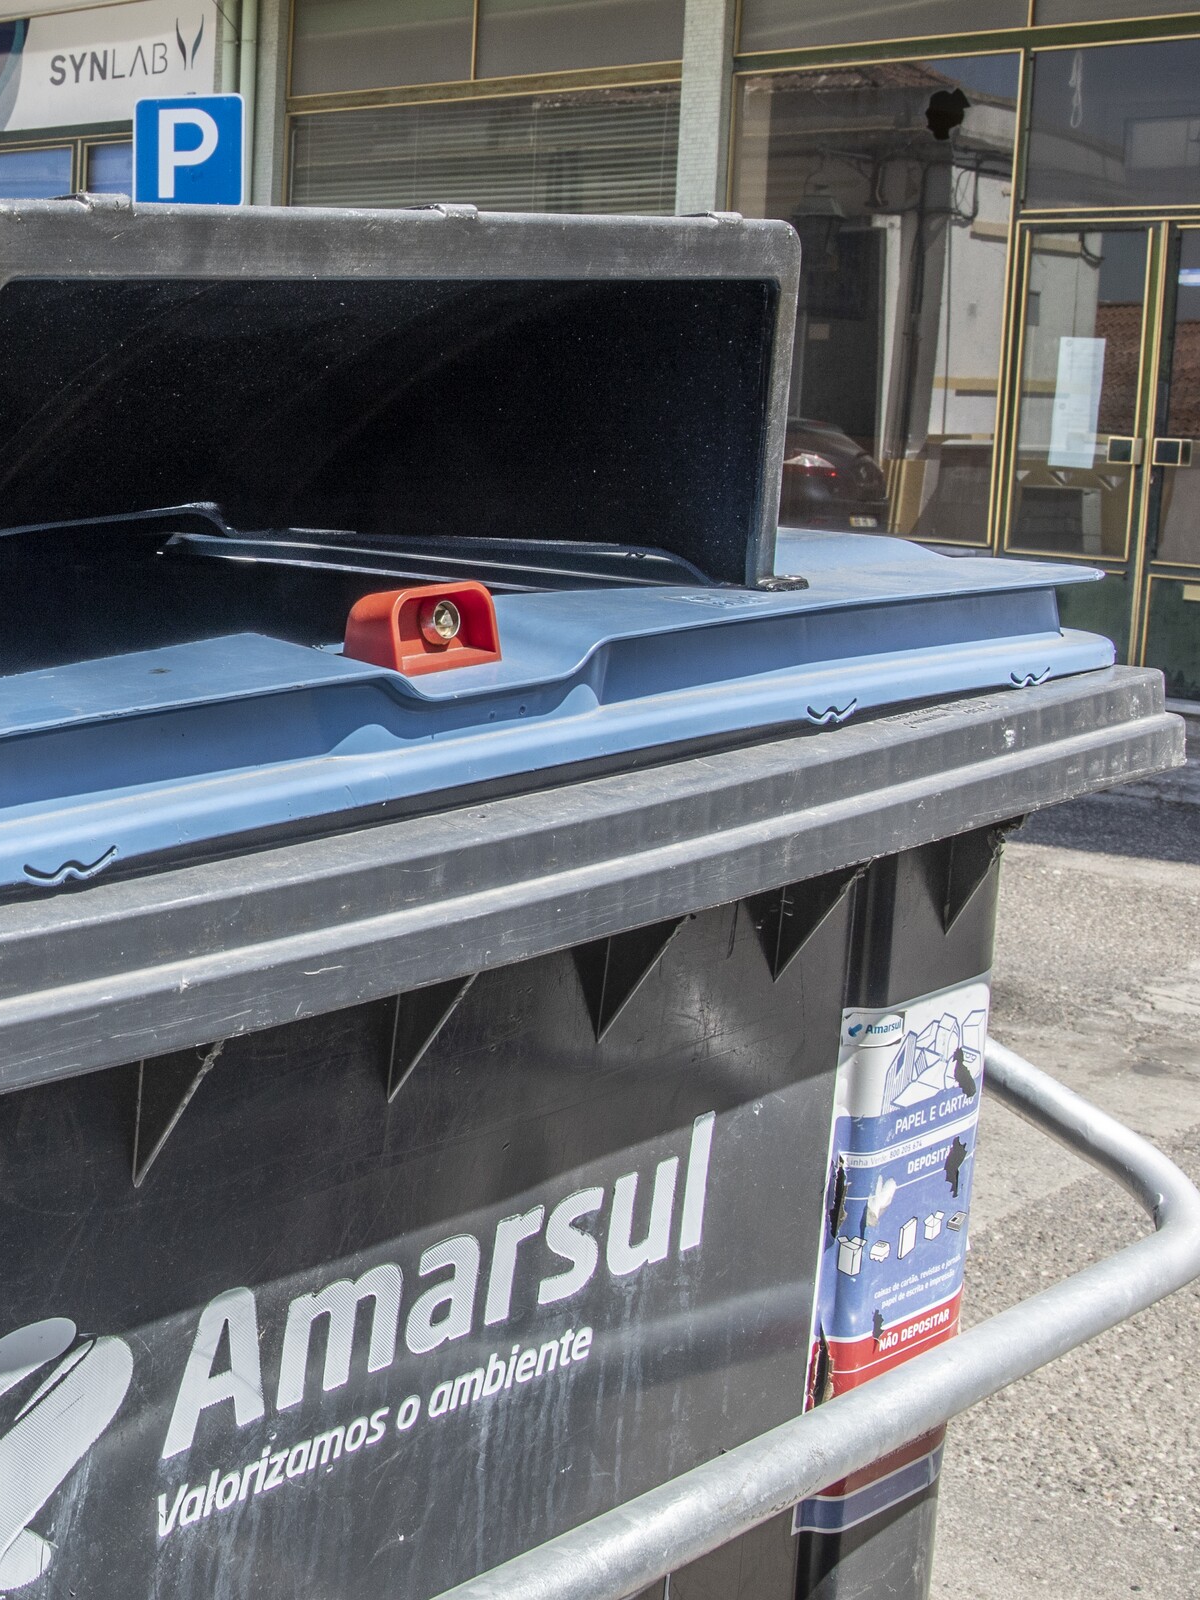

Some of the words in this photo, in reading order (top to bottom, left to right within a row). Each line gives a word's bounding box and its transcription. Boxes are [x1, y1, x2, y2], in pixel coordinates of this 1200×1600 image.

[49, 42, 168, 86] SYNLAB
[158, 107, 219, 199] P
[865, 1018, 901, 1034] Amarsul
[894, 1112, 927, 1135] PAPEL
[930, 1105, 937, 1122] E
[162, 1110, 716, 1460] Amarsul
[879, 1332, 898, 1351] NÃO
[901, 1309, 950, 1342] DEPOSITAR
[157, 1406, 389, 1537] Valorizamos
[396, 1394, 421, 1431] o
[427, 1326, 594, 1419] ambiente
